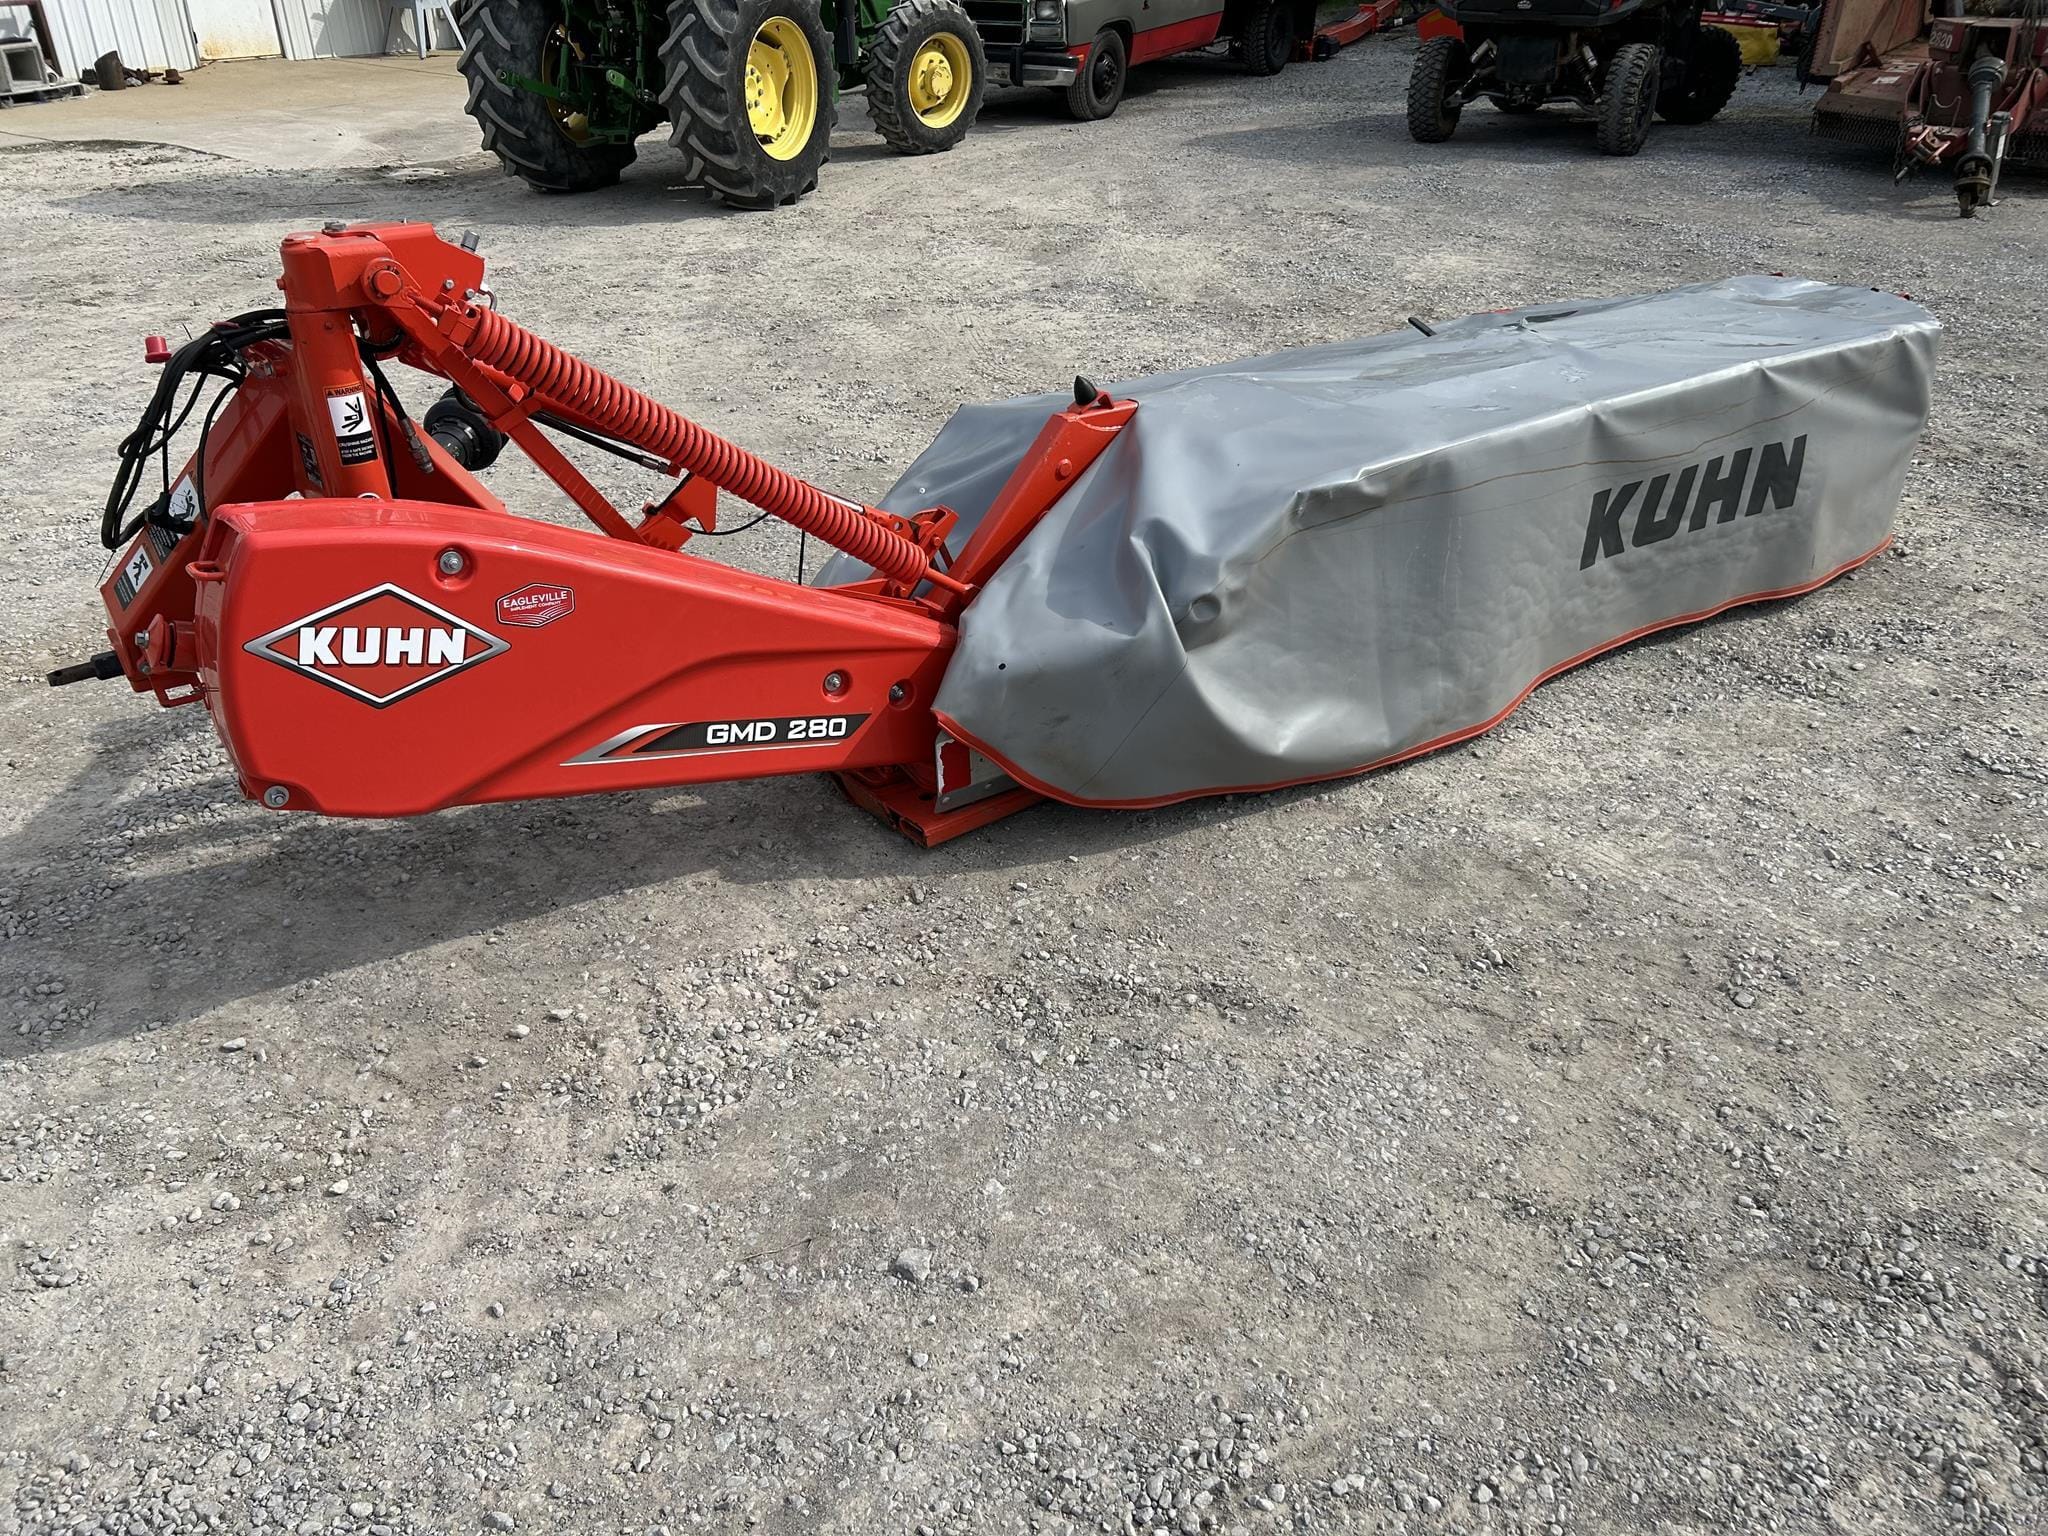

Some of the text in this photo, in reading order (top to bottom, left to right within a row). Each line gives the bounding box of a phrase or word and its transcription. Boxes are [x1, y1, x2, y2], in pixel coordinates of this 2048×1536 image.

[1580, 434, 1807, 571] KUHN
[503, 591, 568, 608] EAGLEVILLE
[298, 626, 466, 665] KUHN
[706, 717, 847, 744] GMD 280
